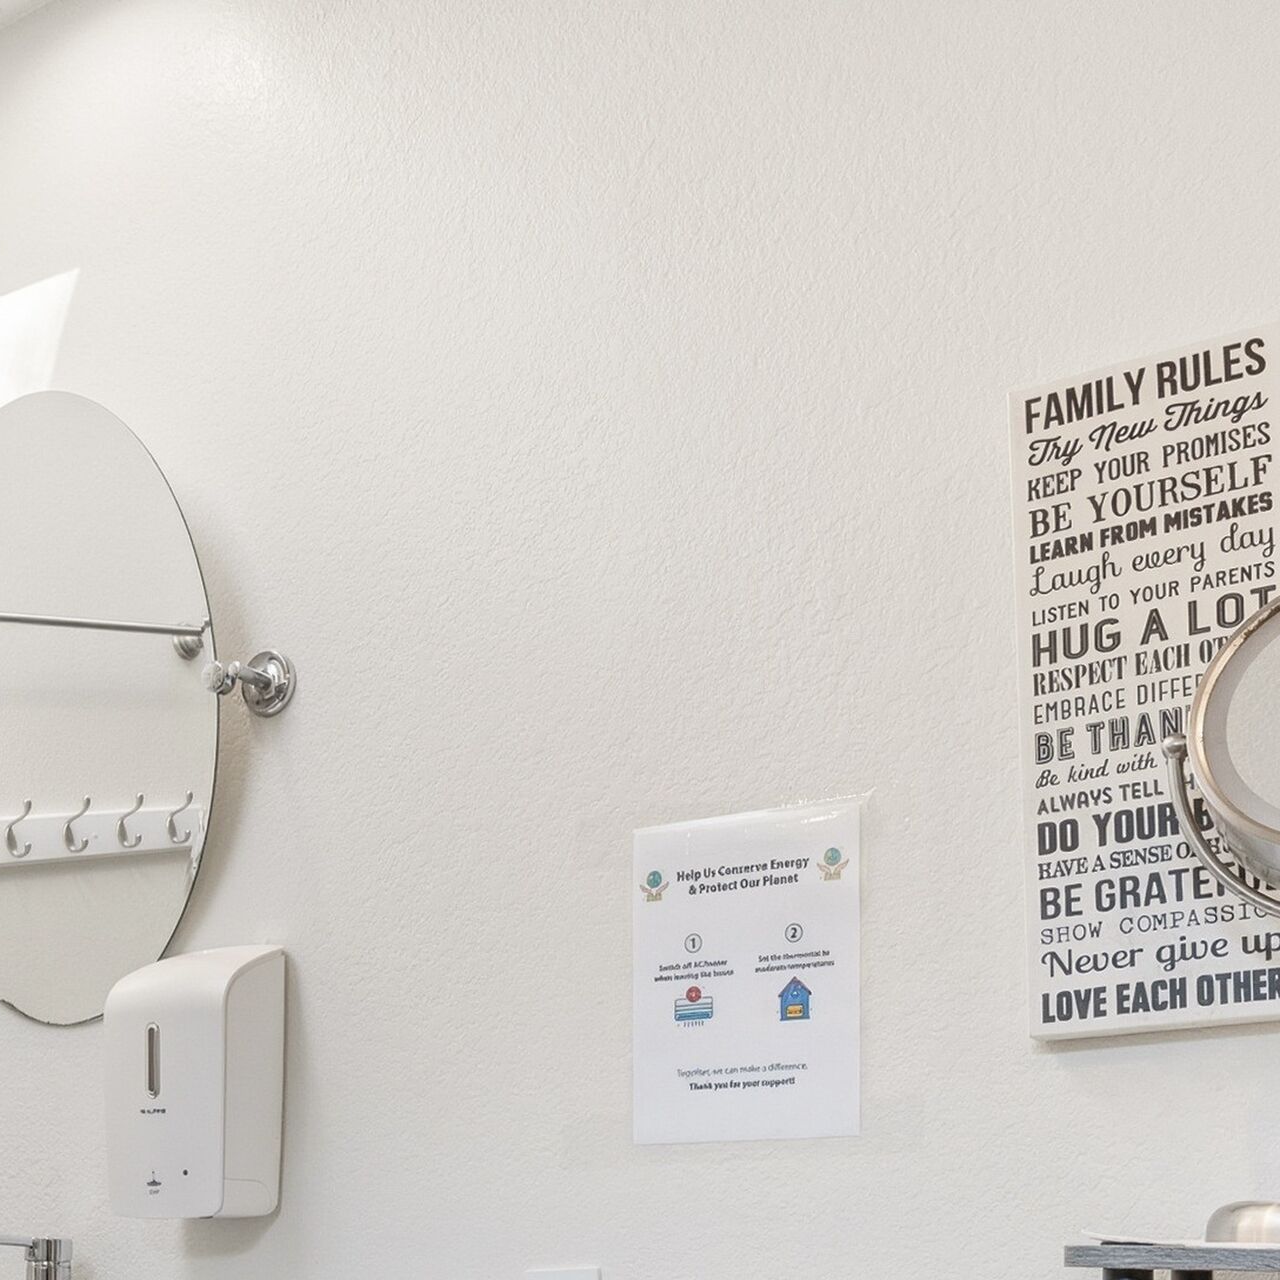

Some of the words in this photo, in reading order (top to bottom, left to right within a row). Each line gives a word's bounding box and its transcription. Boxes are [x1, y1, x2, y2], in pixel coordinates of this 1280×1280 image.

[1025, 367, 1146, 434] FAMILY
[1156, 337, 1267, 399] RULES
[1028, 435, 1083, 467] Try
[1089, 416, 1158, 452] New
[1163, 390, 1269, 432] Things
[1027, 468, 1082, 502] KEEP
[1093, 450, 1151, 484] YOUR
[1162, 421, 1271, 467] PROMISES
[1028, 502, 1073, 539] BE
[1086, 454, 1272, 523] YOURSELF
[1029, 531, 1094, 565] LEARN
[1100, 516, 1157, 548] FROM
[1164, 491, 1274, 533] MISTAKES
[1029, 551, 1122, 597] Laugh
[1131, 540, 1207, 572] every
[1220, 522, 1276, 557] day
[1032, 600, 1090, 627] LISTEN
[1100, 593, 1121, 612] TO
[1129, 580, 1180, 603] YOUR
[1190, 560, 1276, 593] PARENTS
[1032, 617, 1122, 668] HUG
[1140, 608, 1169, 646] A
[1187, 584, 1277, 636] LOT
[1033, 655, 1127, 696] RESPECT
[1134, 641, 1190, 676] EACH
[1033, 688, 1126, 725] EMBRACE
[1034, 726, 1075, 765] BE
[1085, 704, 1191, 755] THAN
[1035, 767, 1061, 789] Be
[1067, 758, 1110, 784] kind
[1116, 752, 1159, 775] with
[1037, 787, 1113, 816] ALWAYS
[1119, 779, 1164, 801] TELL
[1037, 819, 1079, 856] DO
[1092, 802, 1180, 848] YOUR
[676, 868, 702, 883] Help
[703, 867, 716, 879] Us
[770, 857, 810, 871] Energy
[688, 885, 697, 896] &
[698, 879, 738, 895] Protect
[739, 877, 761, 890] Our
[762, 872, 800, 887] Planet
[1038, 857, 1088, 880] HAVE
[1092, 856, 1106, 873] A
[1109, 844, 1172, 869] SENSE
[1040, 883, 1083, 920] BE
[1041, 921, 1102, 945] SHOW
[1041, 946, 1143, 978] Never
[1155, 935, 1229, 972] give
[1041, 985, 1107, 1024] LOVE
[1116, 977, 1188, 1015] EACH
